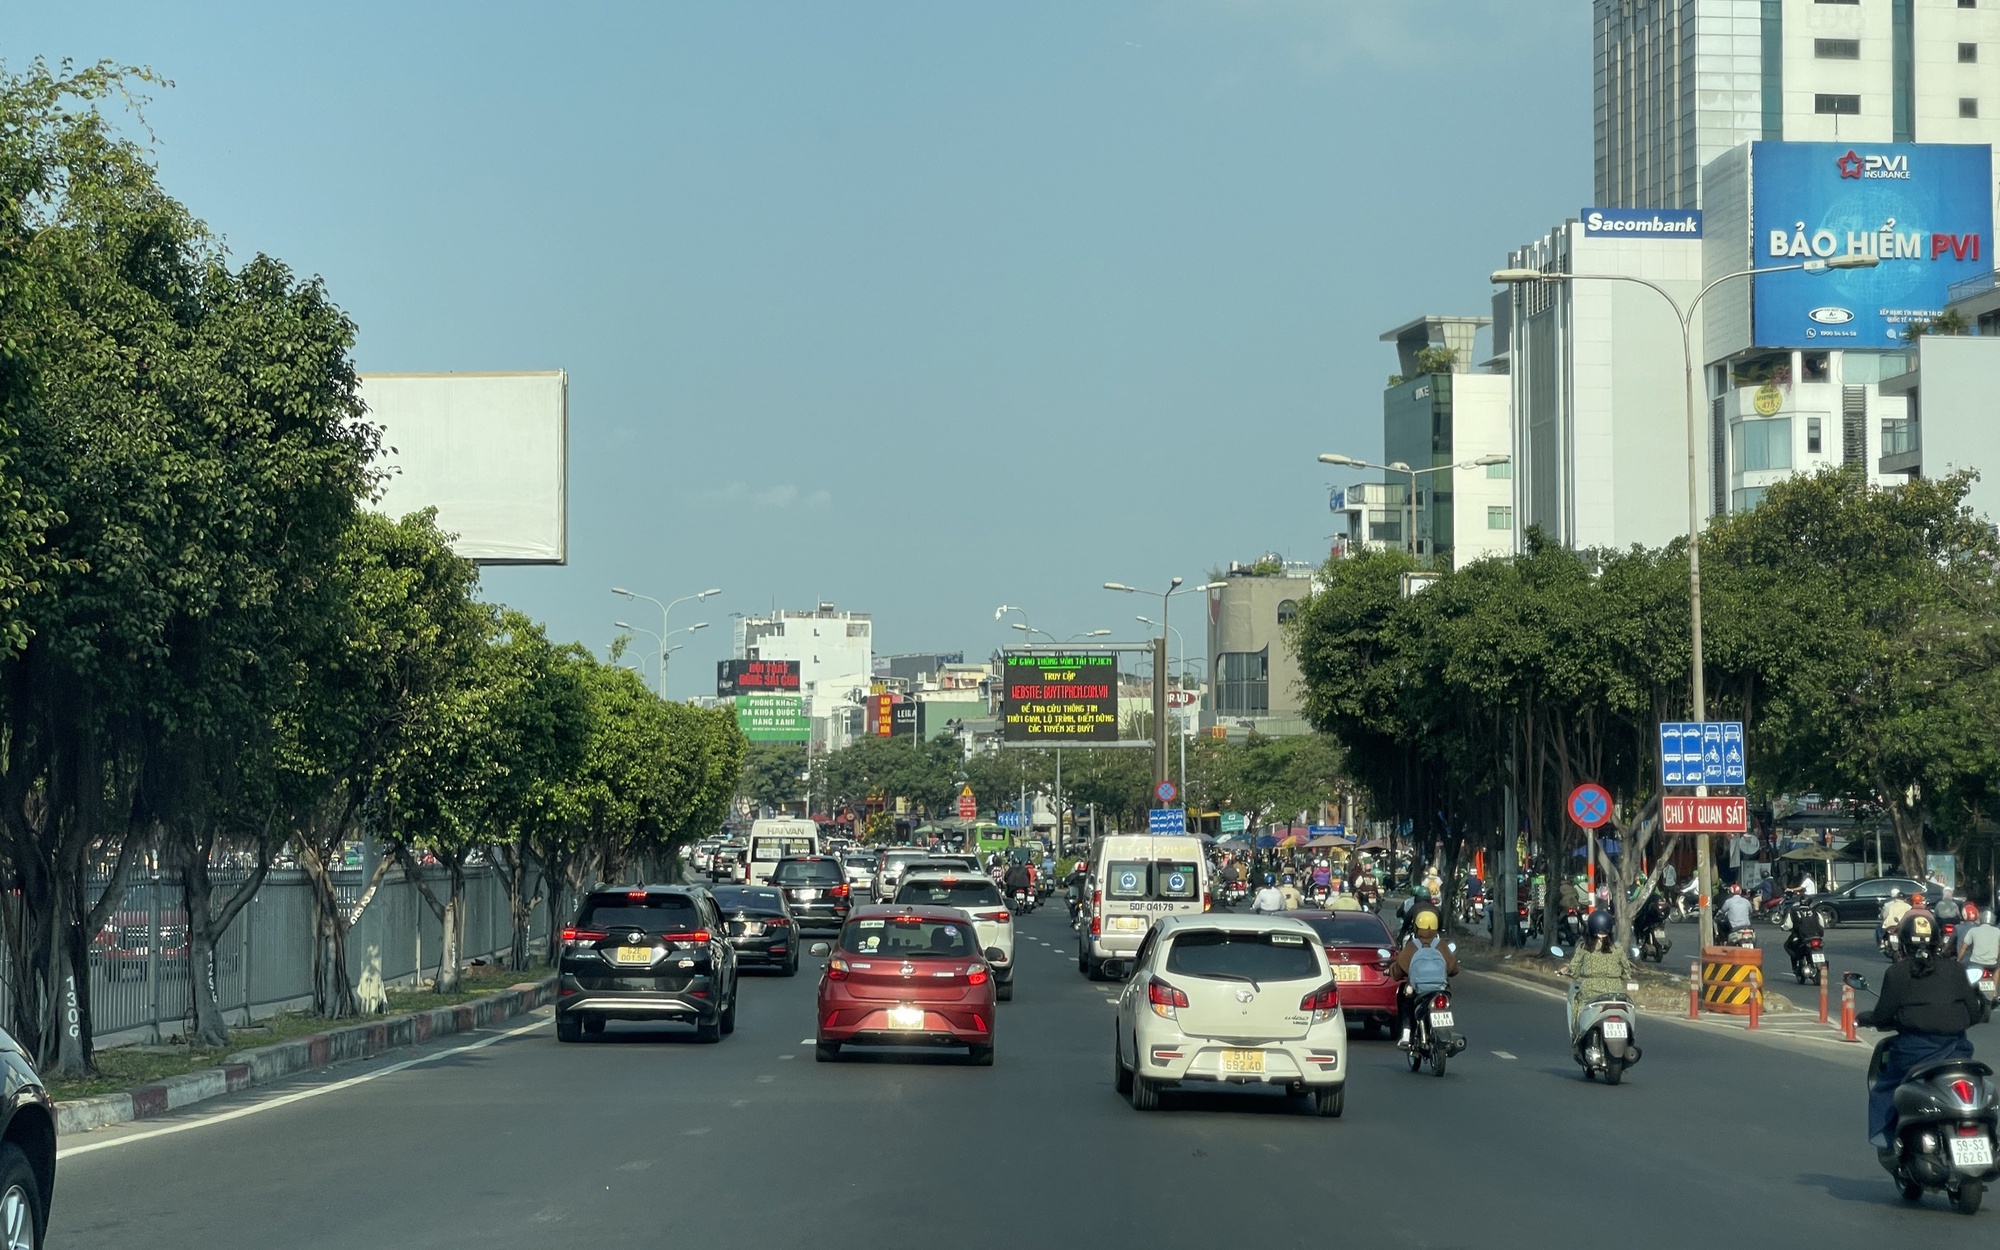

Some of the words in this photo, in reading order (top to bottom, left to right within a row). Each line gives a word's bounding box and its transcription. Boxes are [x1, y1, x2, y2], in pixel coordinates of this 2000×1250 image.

[1864, 155, 1907, 171] PVI
[1864, 170, 1911, 179] INSURANCE
[1587, 212, 1697, 233] Sacombank
[1769, 221, 1838, 257] BẢO
[1847, 217, 1921, 259] HIỂM
[1931, 234, 1981, 261] PVI
[1043, 672, 1061, 681] TRUY
[1062, 670, 1076, 682] CẬP
[1011, 685, 1042, 699] WEBSITE:
[749, 697, 774, 707] PHÒNG
[1021, 702, 1031, 713] ĐỂ
[1032, 705, 1046, 713] TRA
[1063, 703, 1085, 713] THÔNG
[1086, 704, 1098, 713] TIN
[776, 706, 795, 717] QUỐC
[775, 718, 796, 726] XANH
[1028, 723, 1042, 733] CÁC
[1043, 723, 1065, 733] TUYẾN
[1065, 725, 1076, 733] XE
[1077, 723, 1095, 733] BUÝT
[1665, 800, 1684, 824] CHÚ
[1687, 800, 1694, 824] Ý
[1697, 805, 1723, 825] QUAN
[1726, 800, 1744, 825] SÁT
[621, 954, 648, 962] 001.50
[66, 975, 80, 1038] 130G
[1224, 1061, 1261, 1071] 692.40
[1956, 1138, 1985, 1151] 59-S3
[1956, 1151, 1990, 1164] 762.61
